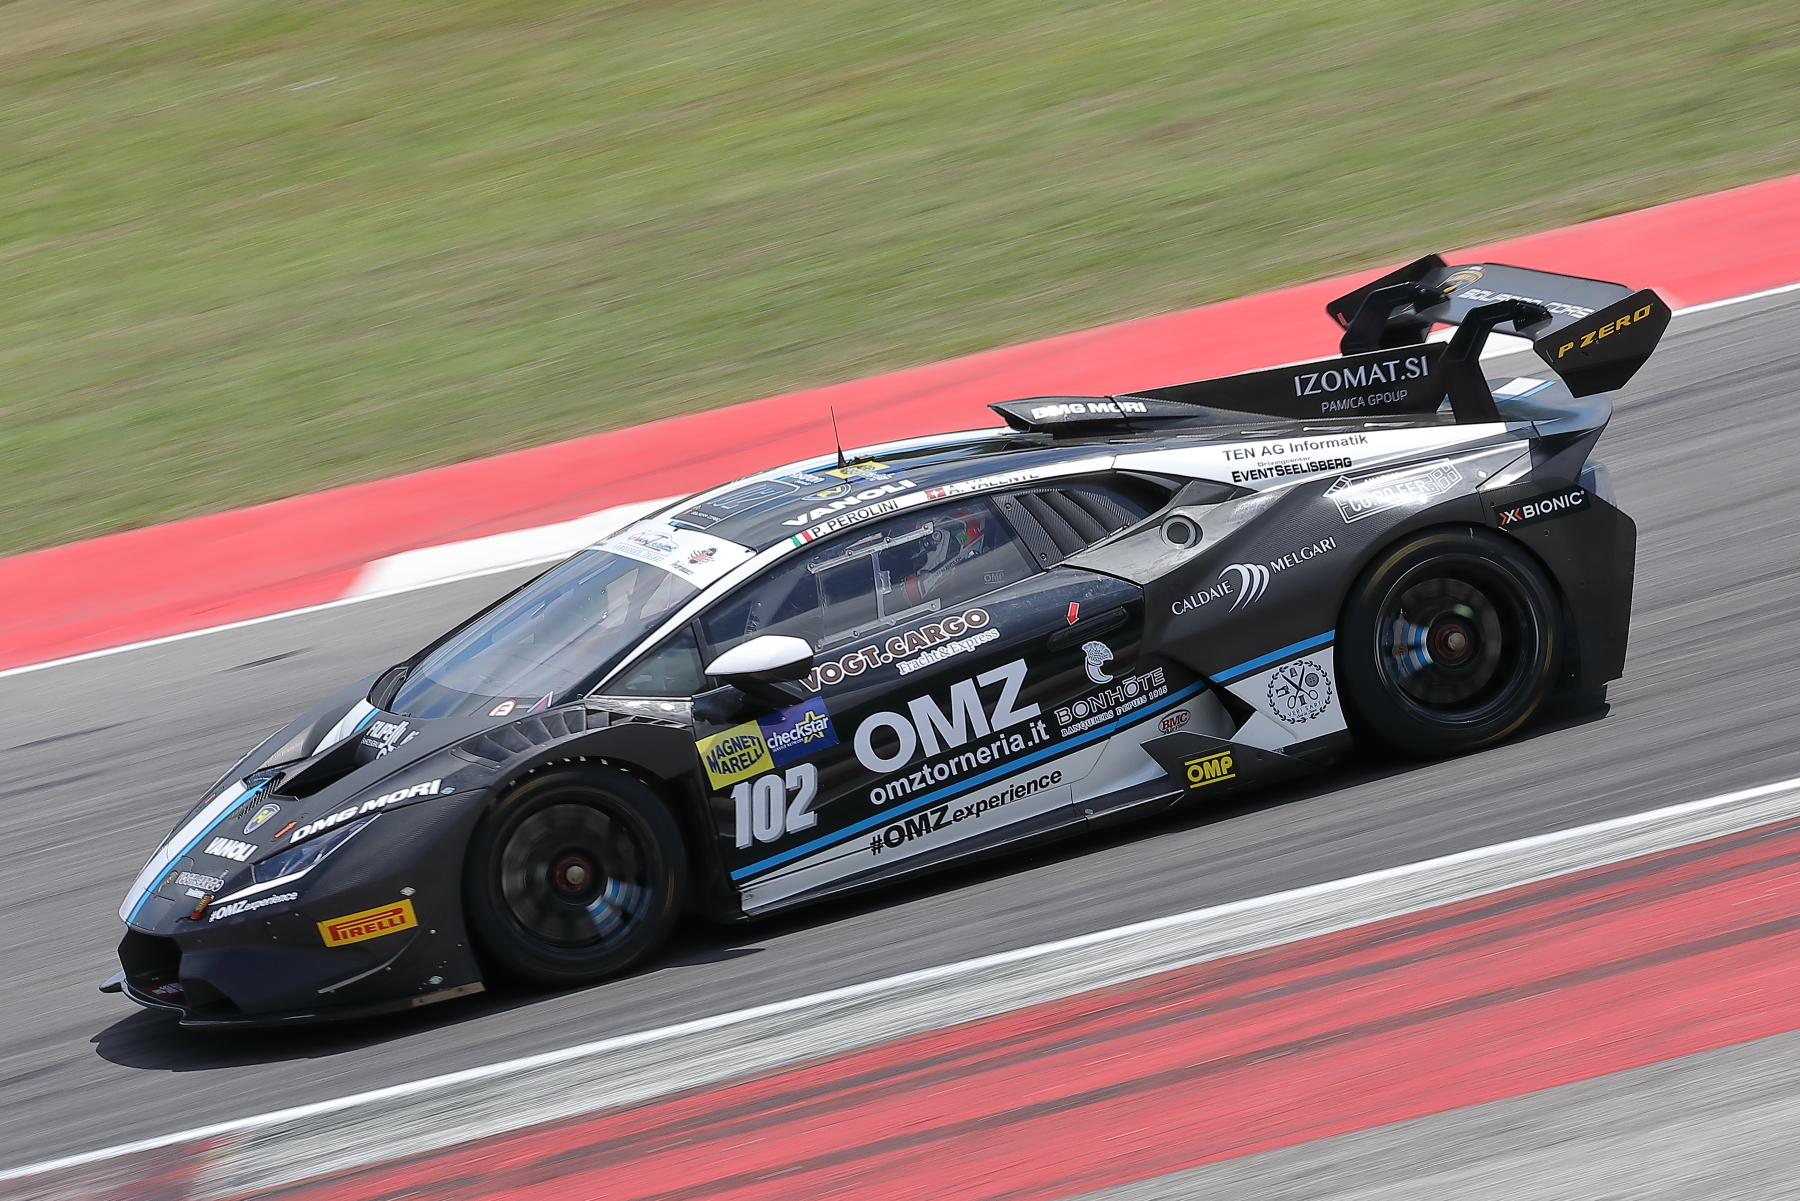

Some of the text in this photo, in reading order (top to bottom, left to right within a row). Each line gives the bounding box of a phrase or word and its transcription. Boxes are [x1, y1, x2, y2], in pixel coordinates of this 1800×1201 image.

[1558, 304, 1652, 359] P ZERO
[1293, 355, 1430, 397] IZOMAT.SI
[1090, 401, 1148, 414] MORI
[1321, 396, 1366, 413] PAMICA
[1222, 435, 1369, 461] TEN AG Informatik
[781, 479, 918, 526] VANOLI
[949, 484, 964, 495] A.
[811, 500, 899, 538] P. PEROLINI
[1171, 536, 1338, 615] CALDAIE MELGARI
[767, 717, 829, 749] checkstar
[854, 658, 1042, 774] OMZ
[1161, 712, 1188, 730] BMC
[706, 735, 764, 767] MAGNETI
[706, 745, 765, 774] MARELLI
[869, 719, 1050, 805] omztorneria.it
[1187, 756, 1233, 782] OMP
[289, 779, 443, 844] DMG MORI
[730, 762, 819, 849] 102
[869, 769, 1063, 856] #OMZexperience
[203, 836, 259, 863] VANOLI
[327, 907, 407, 942] PIRELLI
